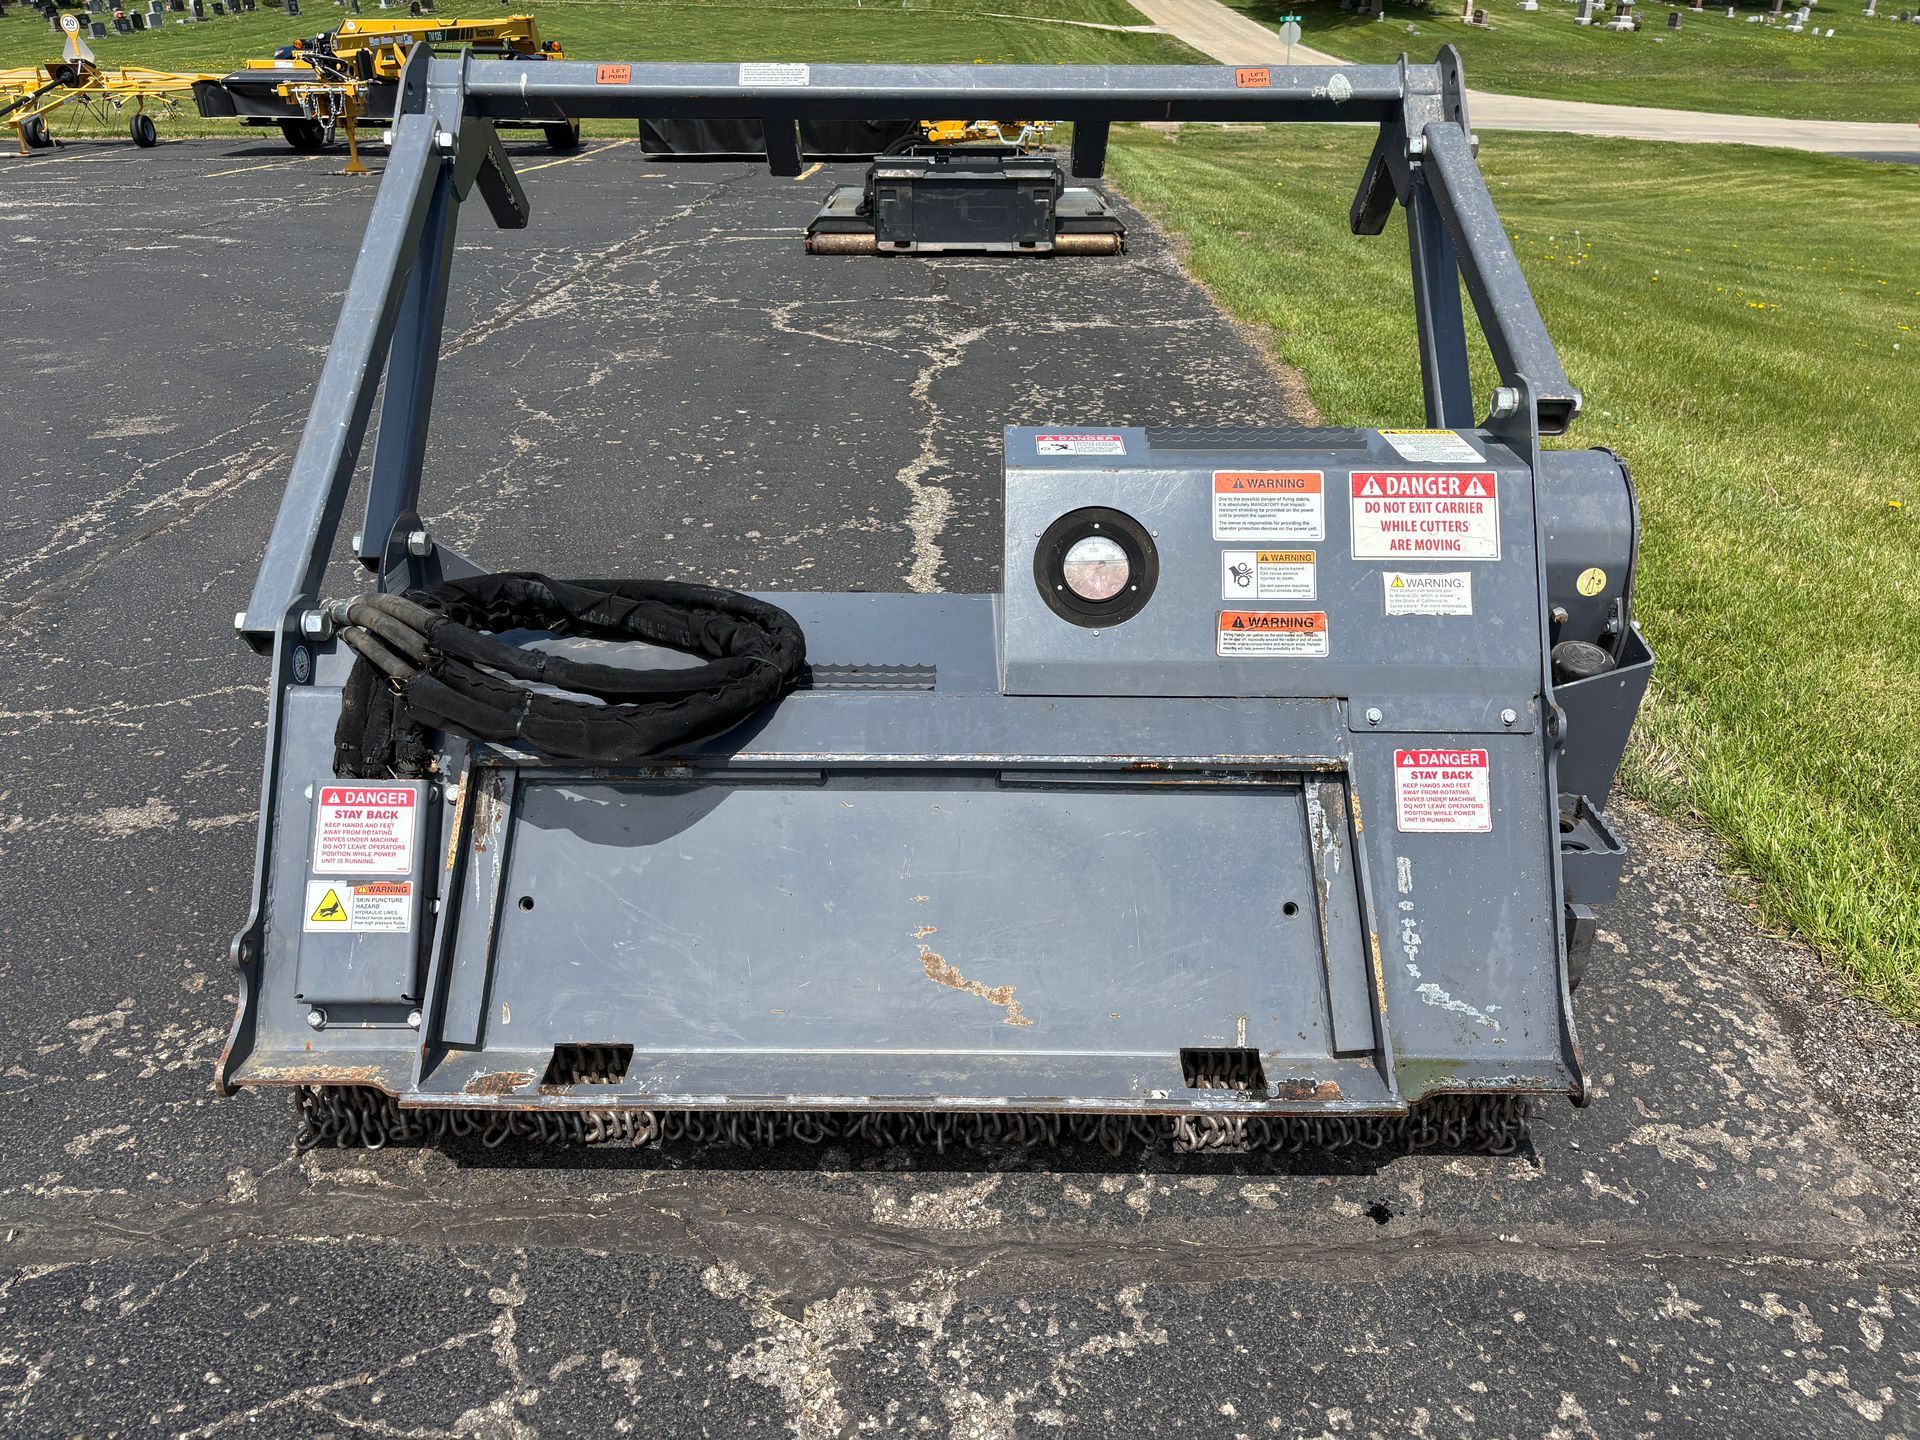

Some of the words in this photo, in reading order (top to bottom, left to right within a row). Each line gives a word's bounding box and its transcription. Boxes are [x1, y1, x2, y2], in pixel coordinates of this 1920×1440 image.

[1247, 479, 1305, 488] WARNING
[1386, 477, 1460, 495] DANGER
[1365, 502, 1380, 513] DO
[1383, 502, 1406, 513] NOT
[1409, 502, 1432, 513] EXIT
[1435, 502, 1483, 513] CARRIER
[1380, 520, 1417, 532] WHILE
[1420, 520, 1469, 532] CUTTERS
[1390, 539, 1411, 551] ARE
[1415, 539, 1461, 551] MOVING
[1406, 579, 1464, 587] WARNING:
[1248, 617, 1314, 628] WARNING
[1419, 754, 1480, 765] DANGER
[1411, 771, 1438, 779] STAY
[1442, 771, 1473, 779] BACK
[345, 792, 408, 804] DANGER
[334, 810, 362, 819] STAY
[367, 810, 399, 819] BACK
